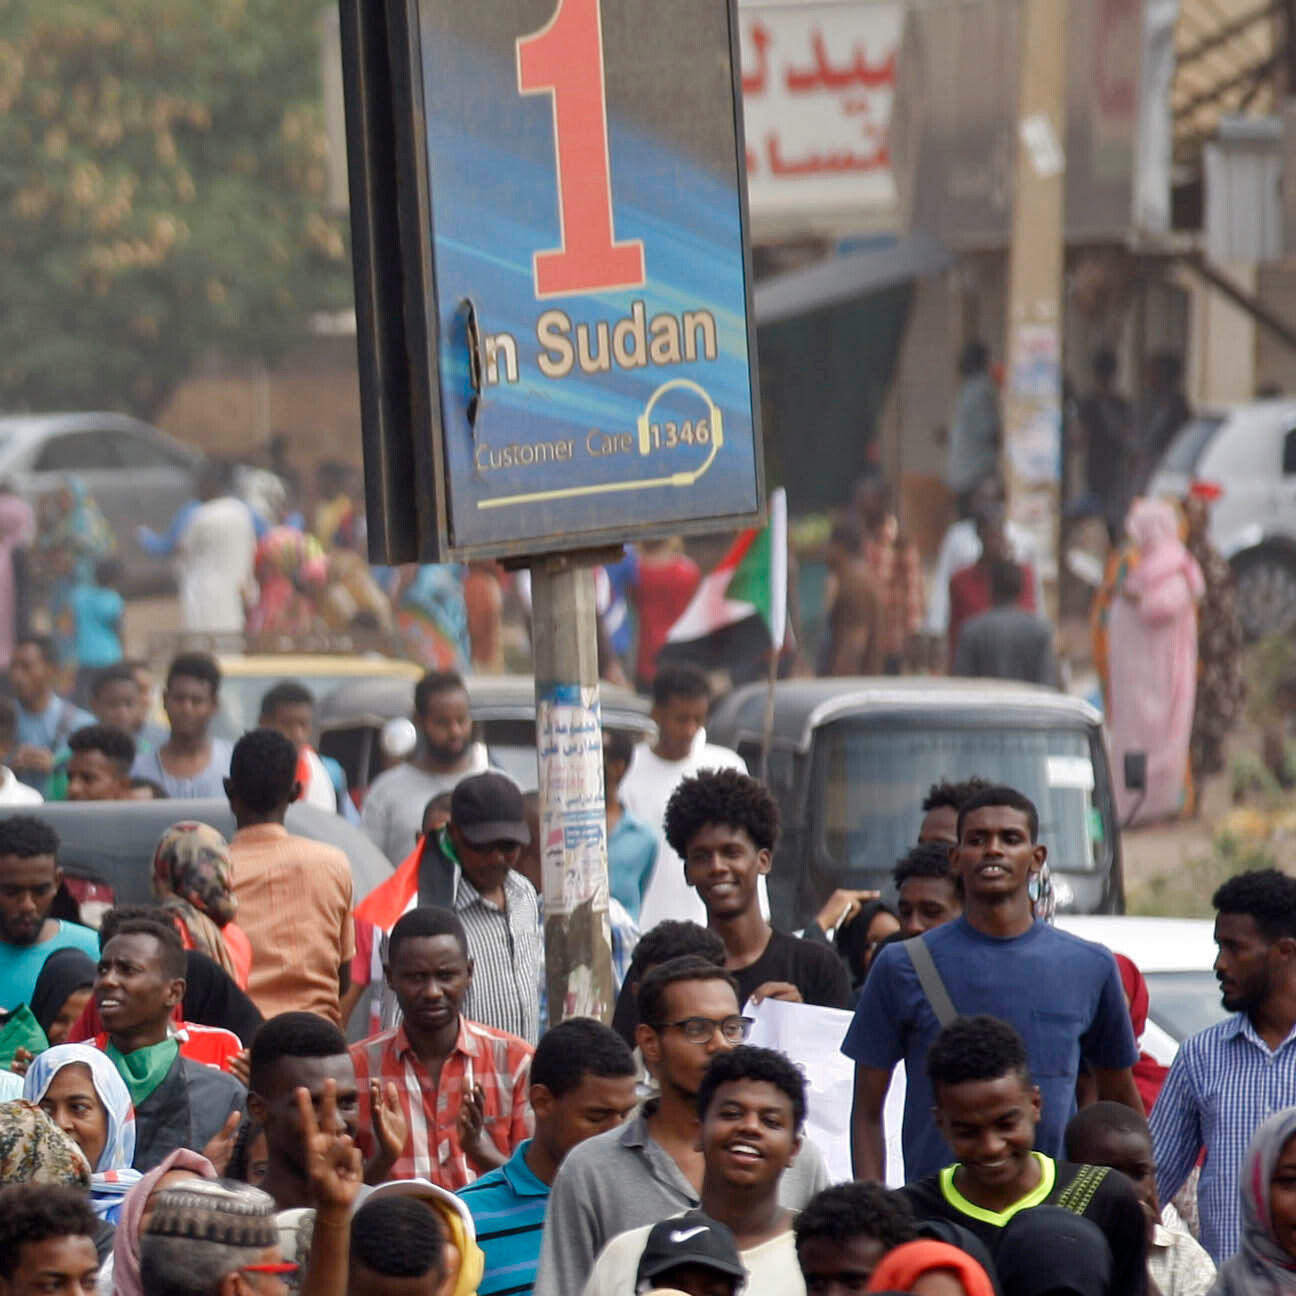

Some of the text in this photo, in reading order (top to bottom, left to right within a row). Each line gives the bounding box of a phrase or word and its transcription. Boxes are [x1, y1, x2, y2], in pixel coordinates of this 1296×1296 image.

[516, 0, 646, 299] 1
[474, 299, 718, 385] n Sudan
[474, 416, 710, 473] Customer Care 1346
